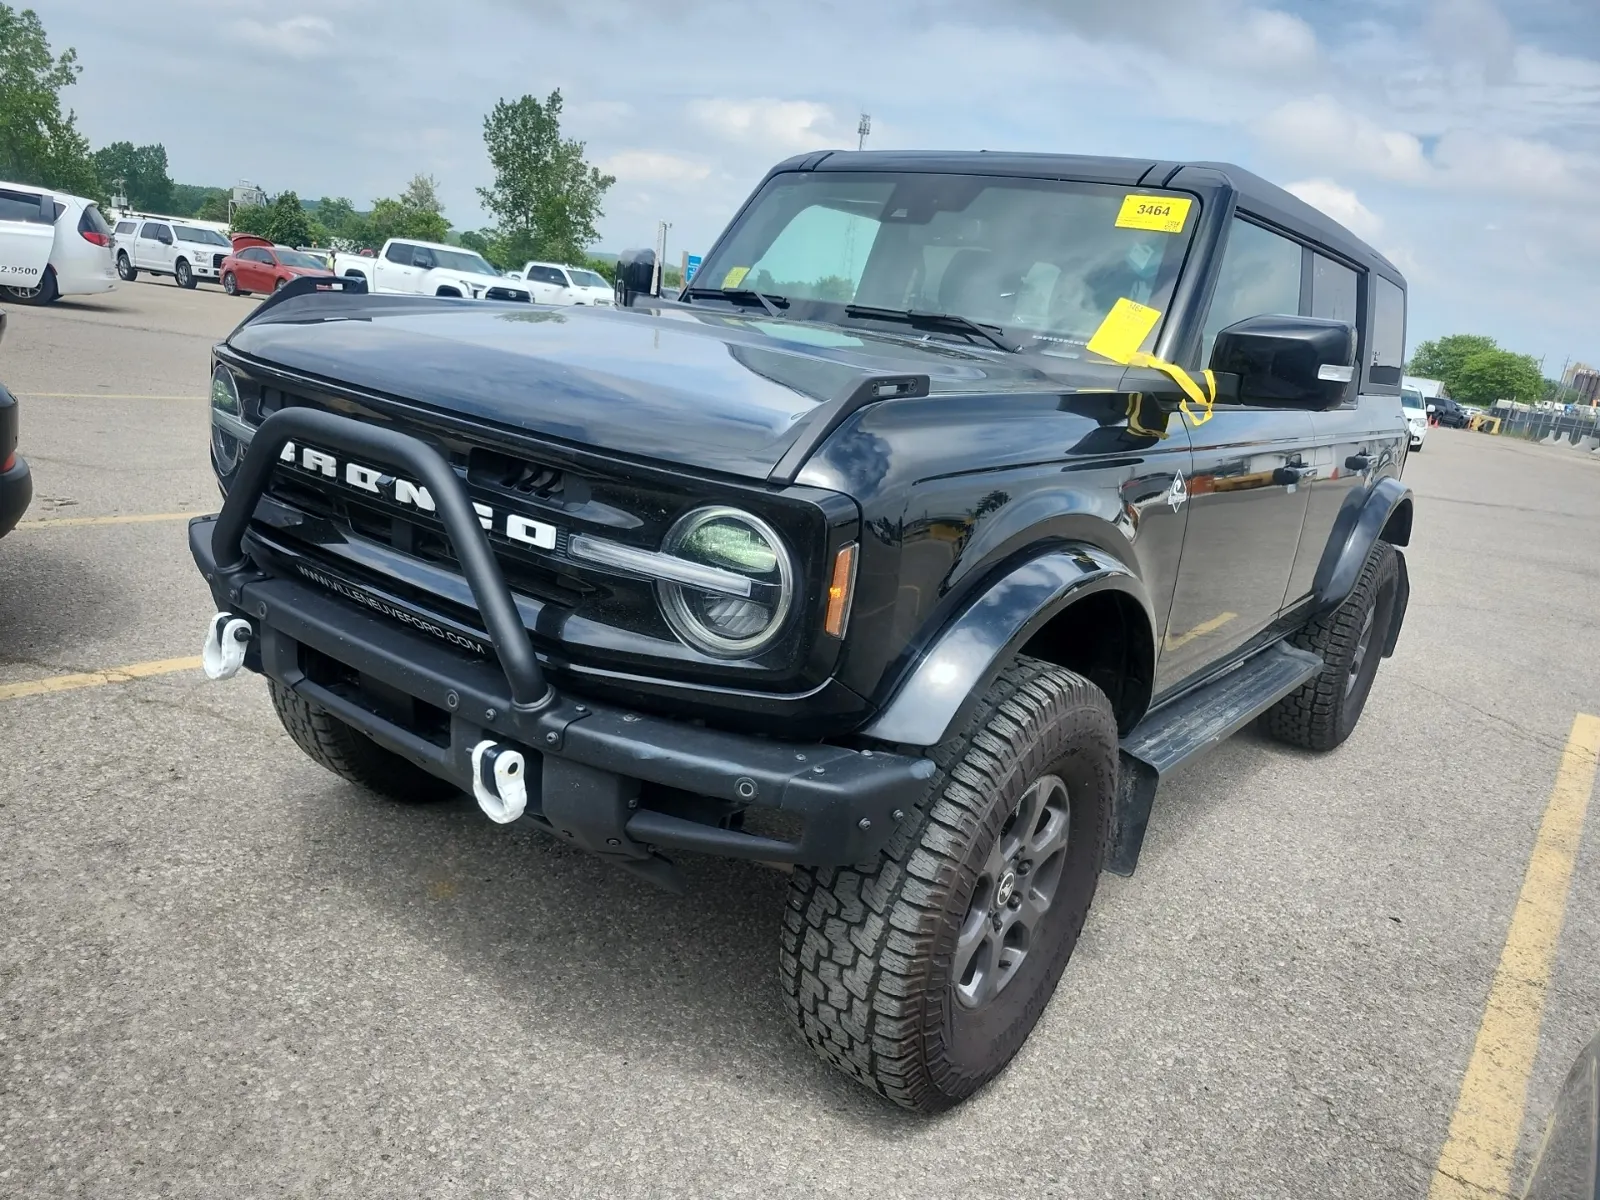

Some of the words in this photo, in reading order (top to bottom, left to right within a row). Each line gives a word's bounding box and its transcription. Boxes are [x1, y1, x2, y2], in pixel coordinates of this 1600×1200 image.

[1136, 204, 1171, 216] 3464
[0, 265, 38, 275] 2.9500
[296, 564, 486, 654] WWW.VILLENEUVEFORD.COM
